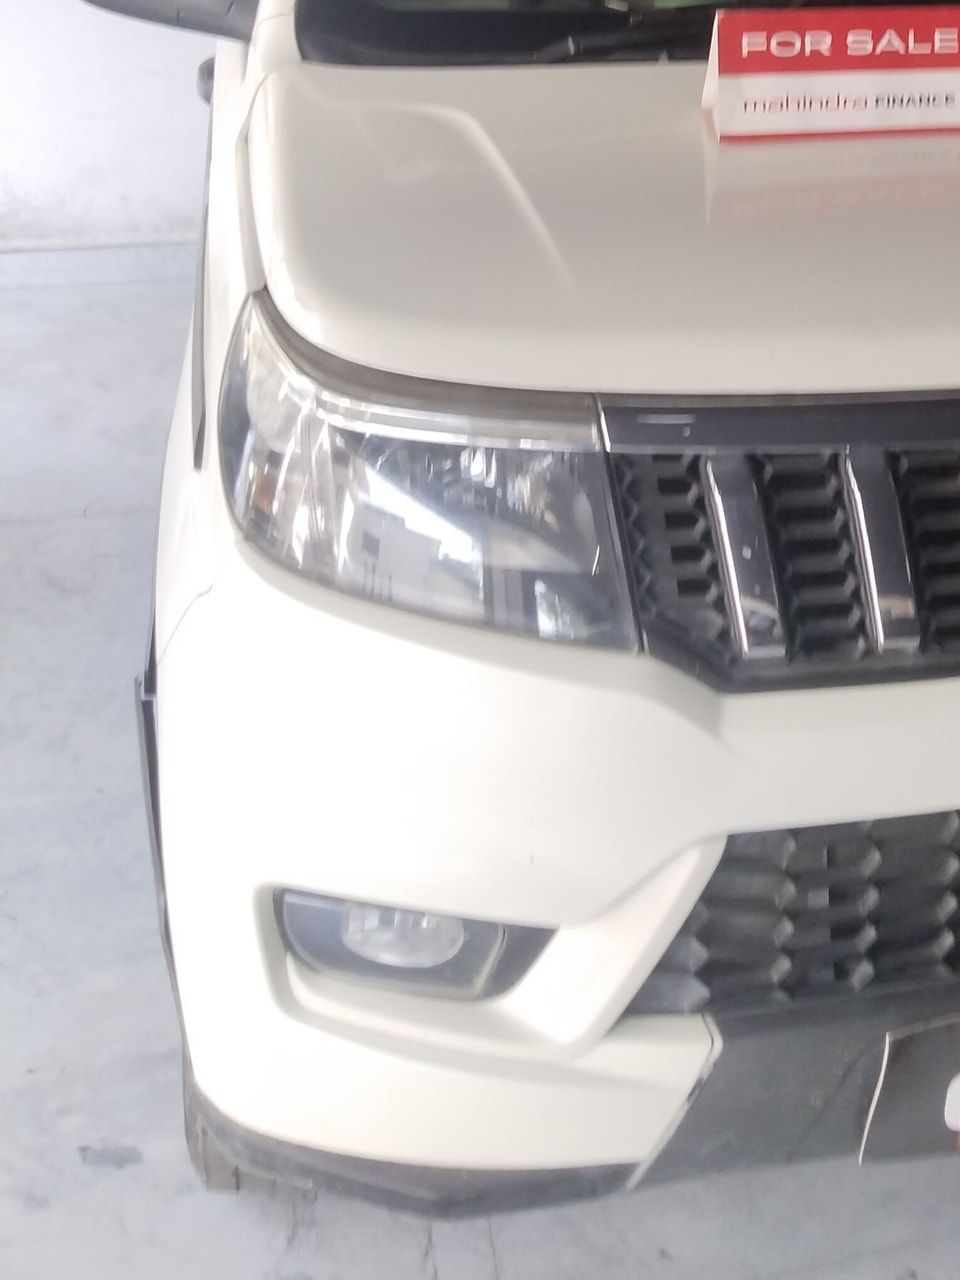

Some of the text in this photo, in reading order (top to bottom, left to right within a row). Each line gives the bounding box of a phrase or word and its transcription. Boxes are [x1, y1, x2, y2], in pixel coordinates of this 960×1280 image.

[741, 27, 960, 58] FOR SALE
[875, 91, 956, 110] FINANCE
